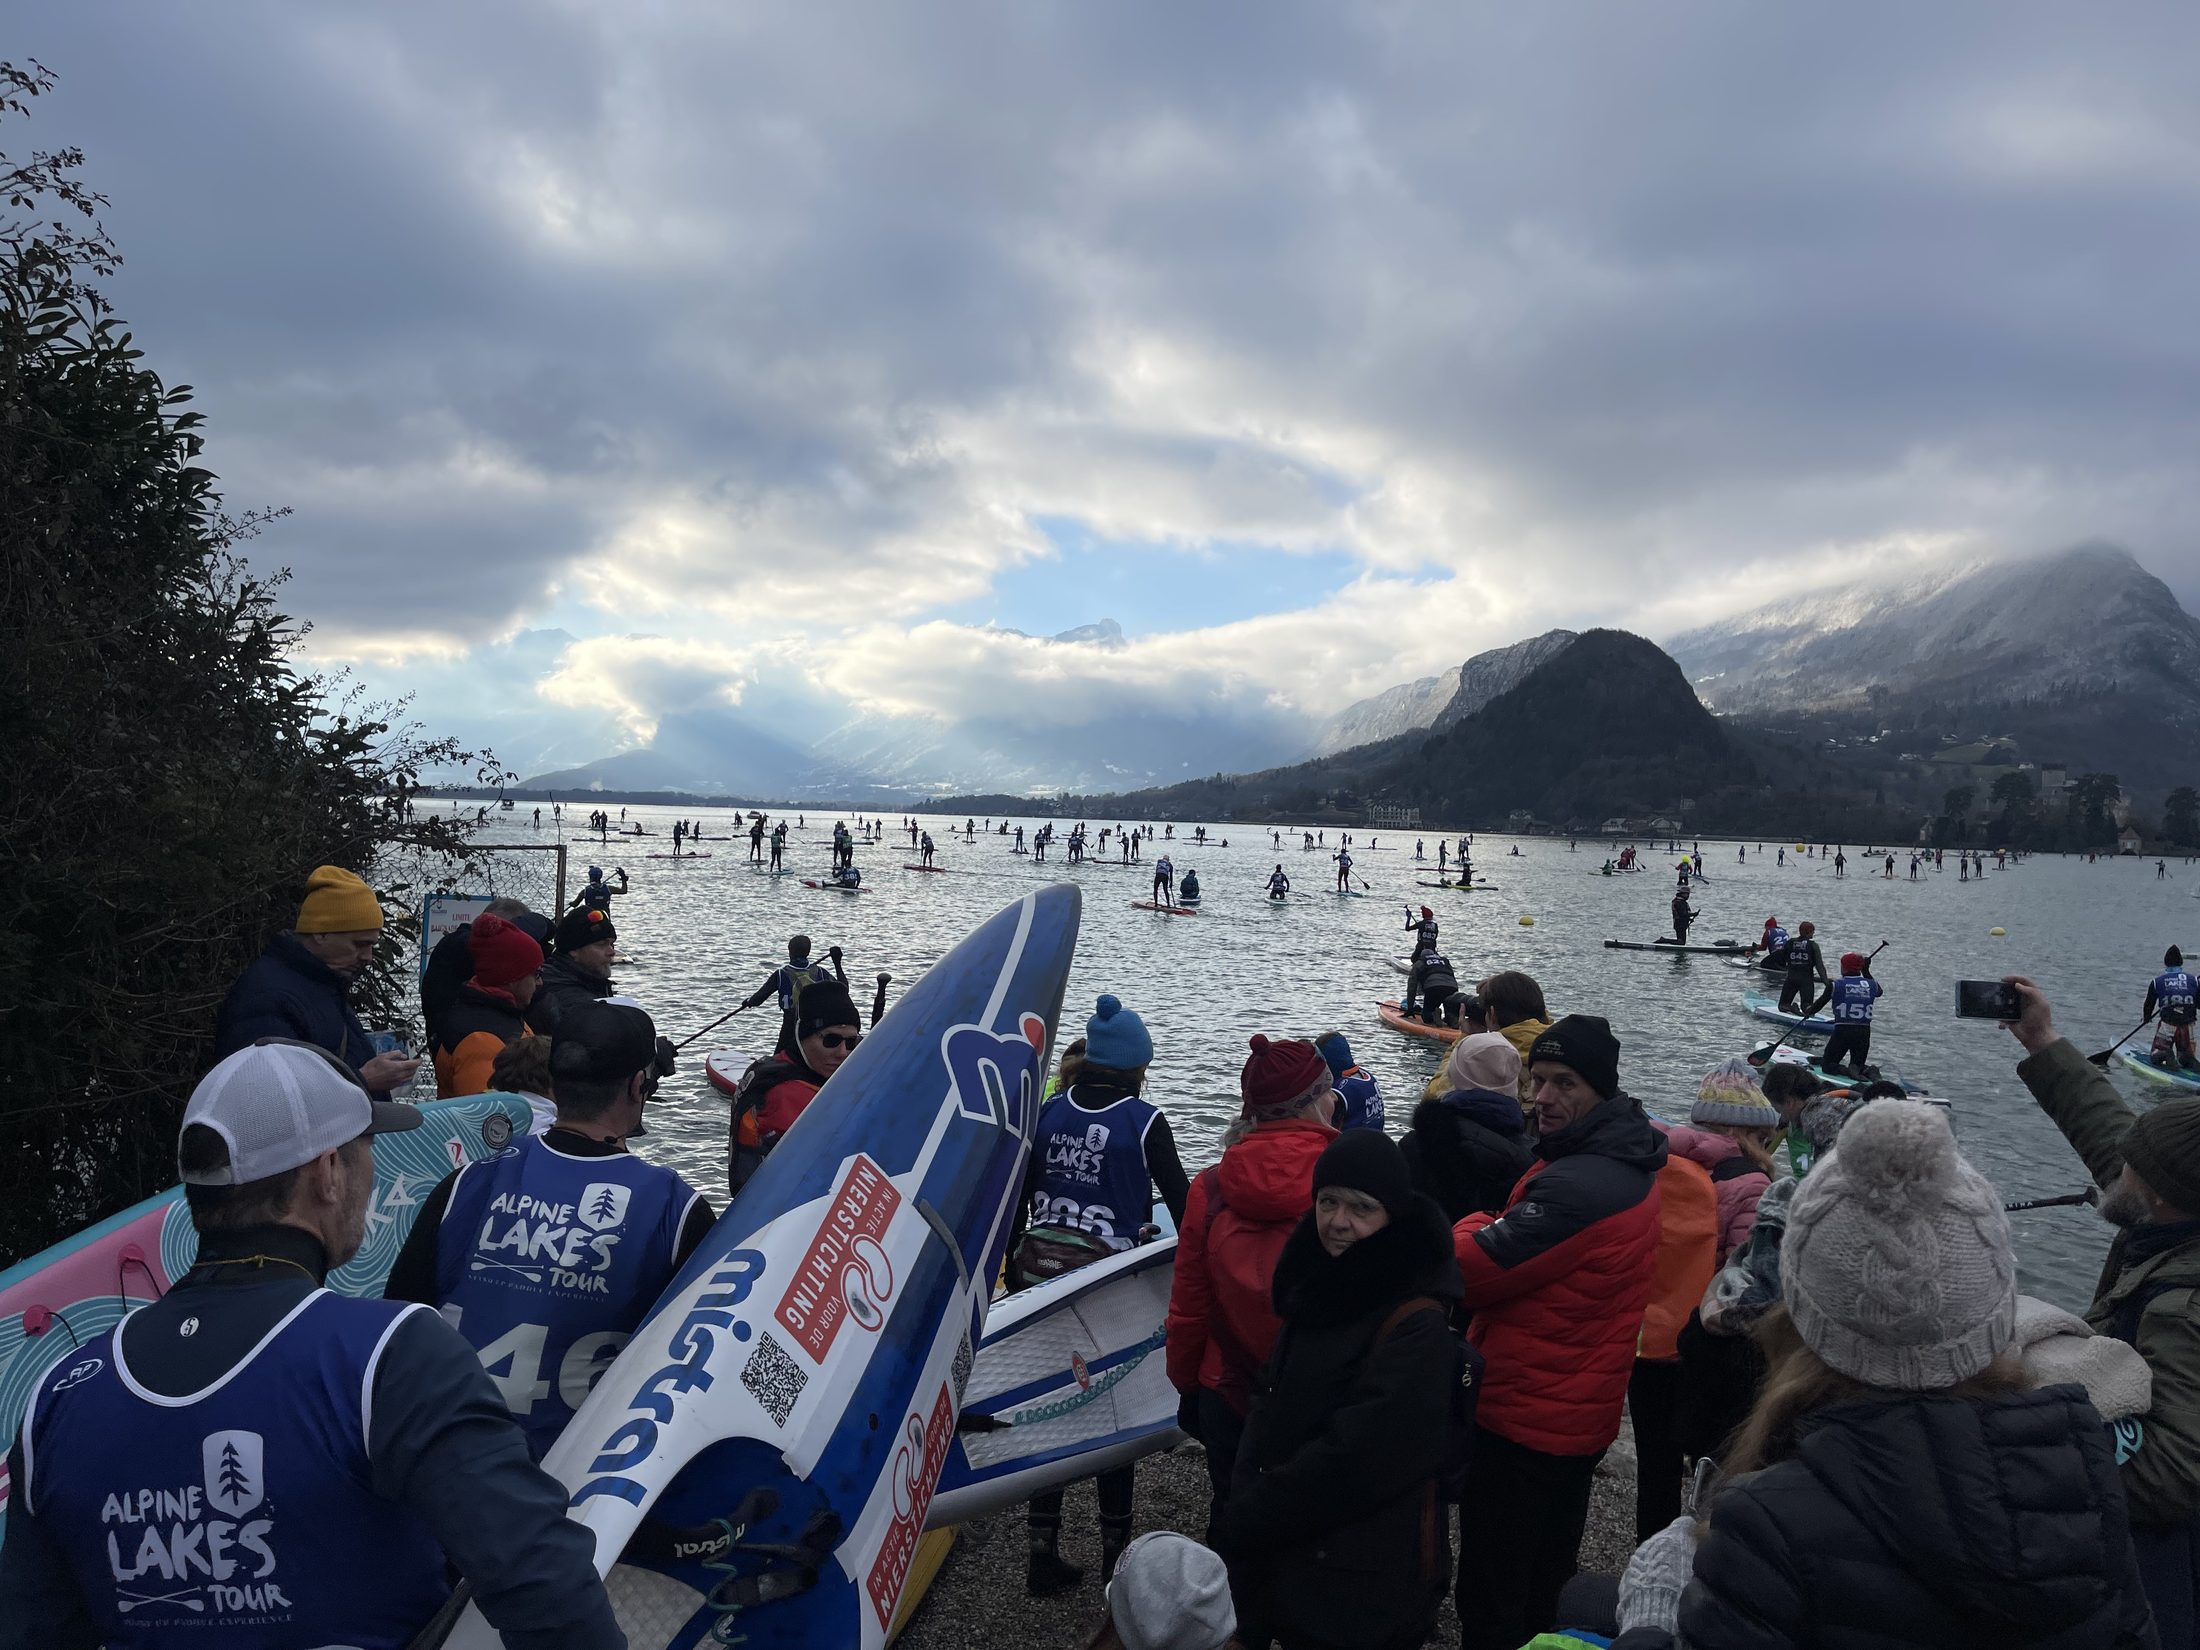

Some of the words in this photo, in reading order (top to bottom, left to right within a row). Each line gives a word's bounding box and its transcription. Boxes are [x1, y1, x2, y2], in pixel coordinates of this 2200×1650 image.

[1790, 952, 1809, 961] 643
[1050, 1133, 1085, 1148] ALPINE
[1046, 1147, 1104, 1174] LAKES
[1074, 1170, 1100, 1186] TOUR
[490, 1192, 575, 1225] ALPINE
[882, 1188, 893, 1204] IN
[866, 1200, 888, 1234] ACTIE
[477, 1218, 623, 1271] LAKES
[786, 1166, 878, 1330] NIERSTICHTING
[549, 1267, 610, 1294] TOUR
[818, 1295, 842, 1330] VOOR
[809, 1332, 824, 1349] DE
[569, 1249, 767, 1508] mistral
[101, 1486, 202, 1523] ALPINE
[873, 1575, 882, 1592] IN
[881, 1525, 900, 1572] ACTIE
[926, 1418, 942, 1448] VOOR
[940, 1396, 948, 1414] DE
[880, 1414, 952, 1618] NIERSTICHTING
[107, 1520, 276, 1582] LAKES
[207, 1582, 293, 1613] TOUR
